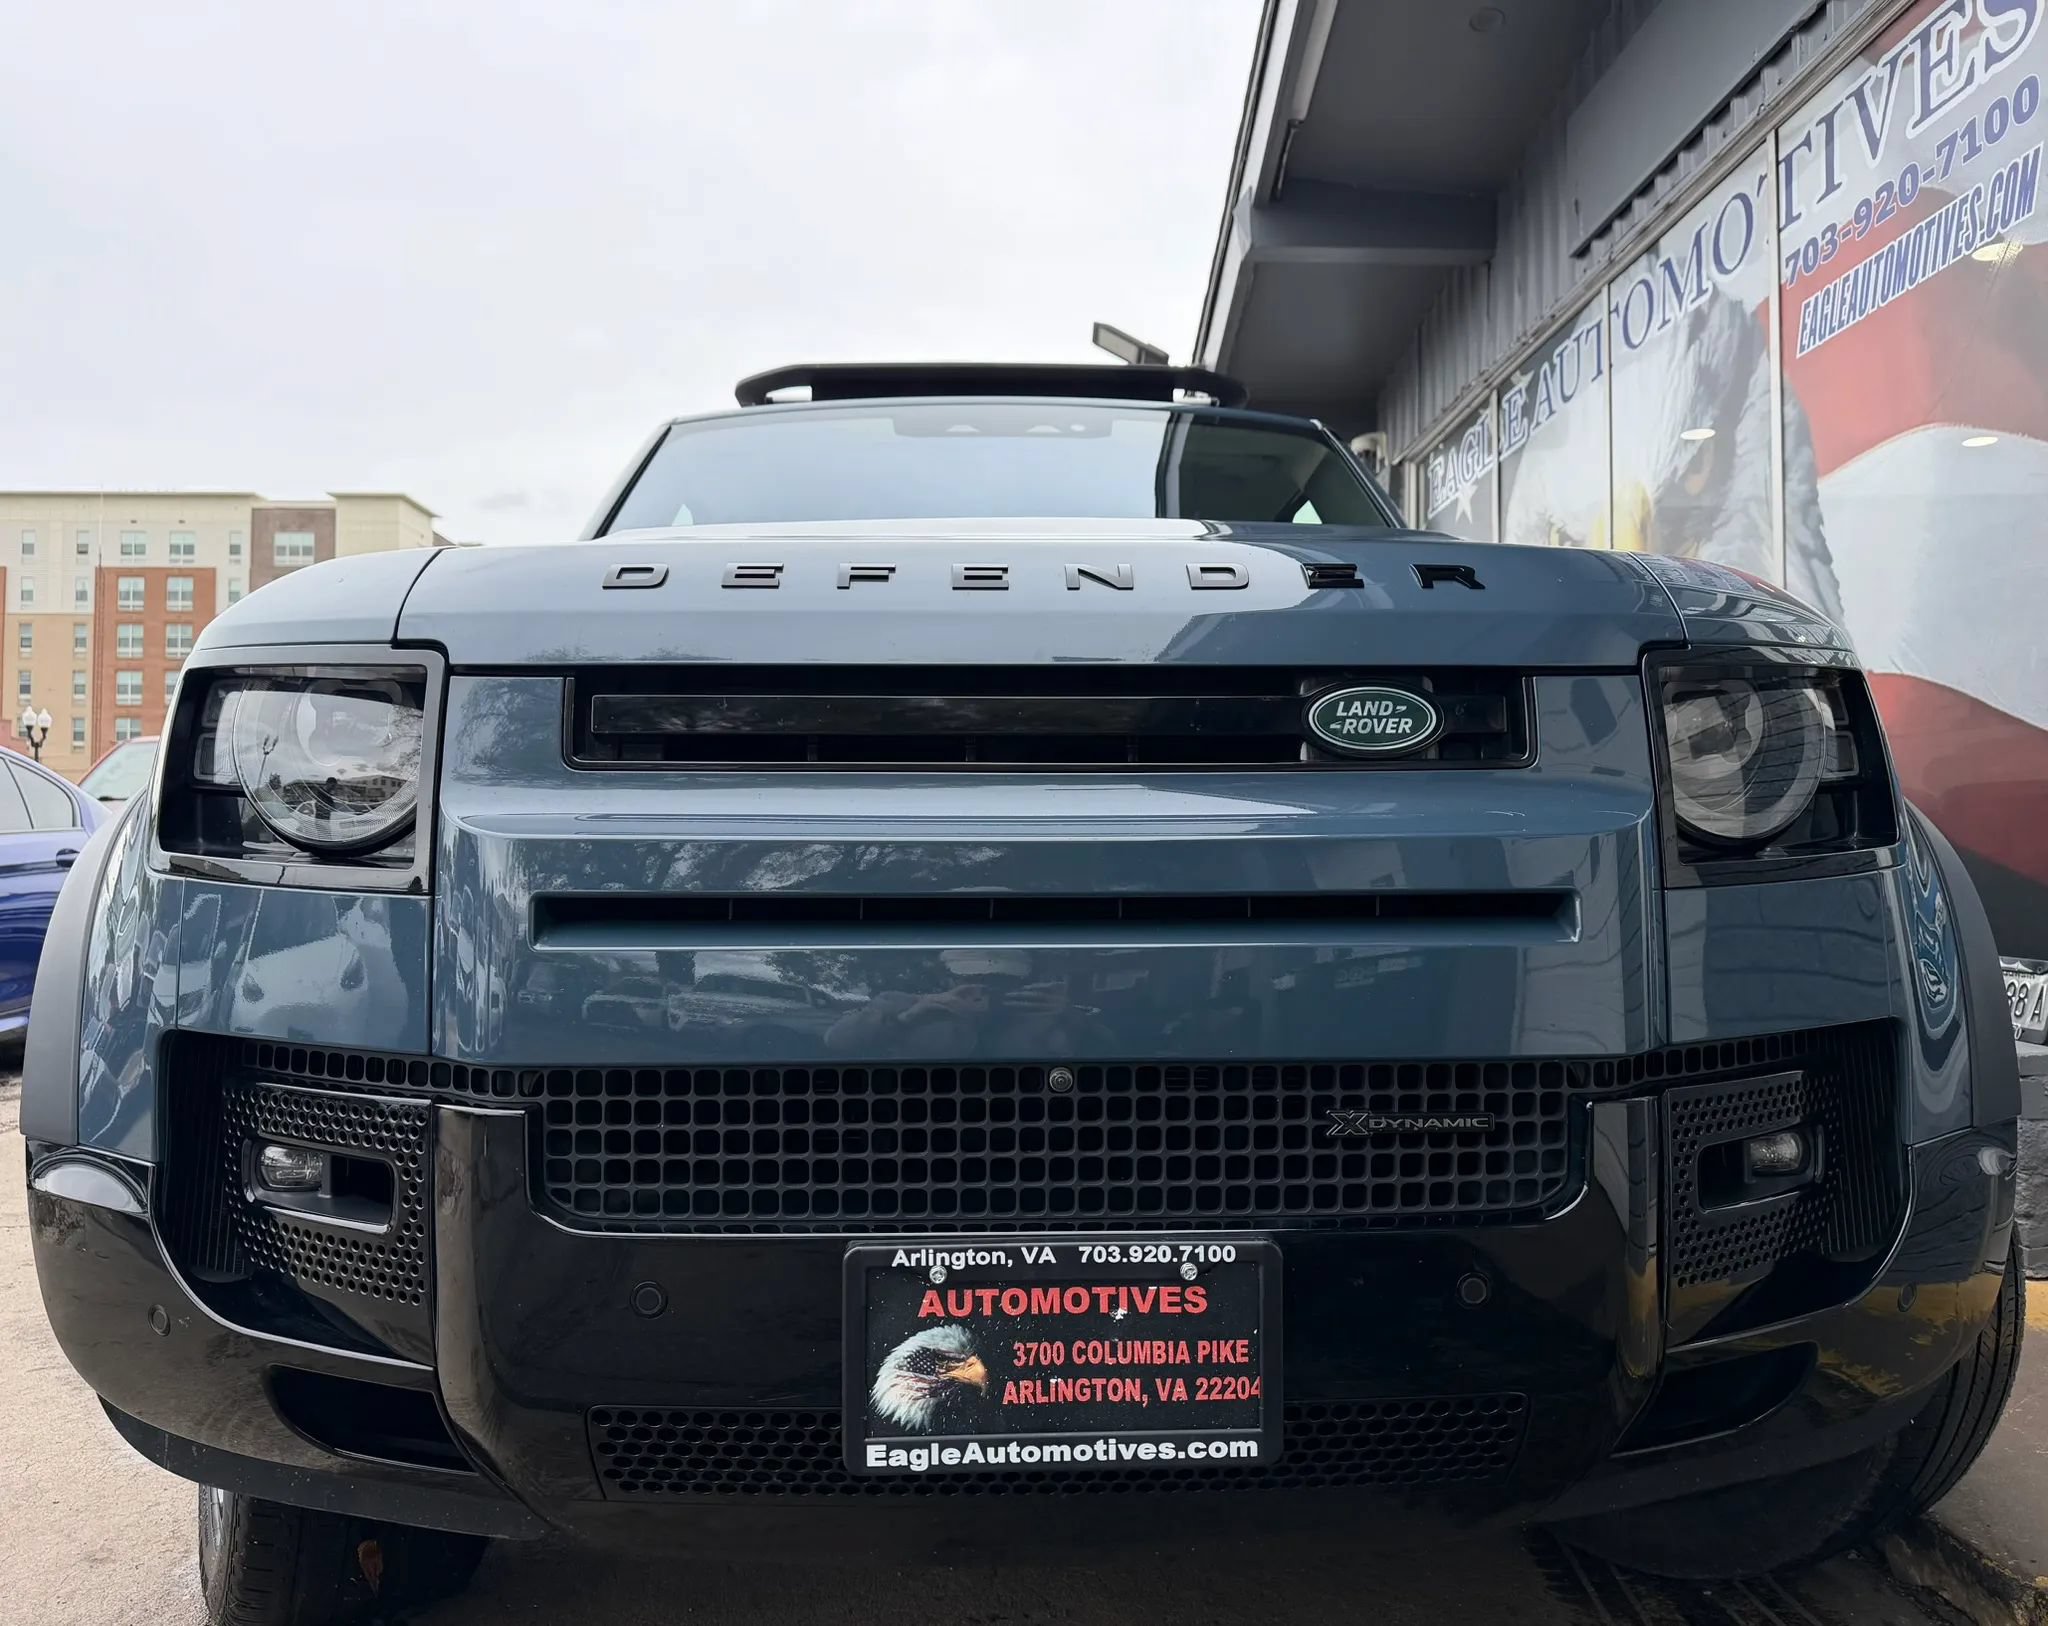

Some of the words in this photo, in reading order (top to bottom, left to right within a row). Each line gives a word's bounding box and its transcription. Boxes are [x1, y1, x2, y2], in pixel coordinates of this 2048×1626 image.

[1784, 73, 2040, 289] 703-920-7100
[1428, 384, 1529, 516] EAGLE
[1531, 0, 2045, 432] AUTOMOTIVES
[1797, 142, 2044, 358] EAGLEAUTOMOTIVES.COM
[602, 562, 1486, 590] DEFENDER
[1342, 717, 1412, 734] ROVER
[892, 1247, 1014, 1269] Arlington,
[1021, 1246, 1057, 1265] VA
[1079, 1245, 1236, 1264] 703.920.7100
[917, 1286, 1208, 1318] AUTOMOTIVES
[1013, 1341, 1065, 1366] 3700
[1072, 1340, 1190, 1365] COLUMBIA
[1197, 1339, 1249, 1363] PIKE
[1002, 1378, 1149, 1407] ARLINGTON,
[1156, 1378, 1189, 1401] VA
[1195, 1375, 1262, 1400] 22204
[866, 1438, 1258, 1471] EagleAutomotives.com
